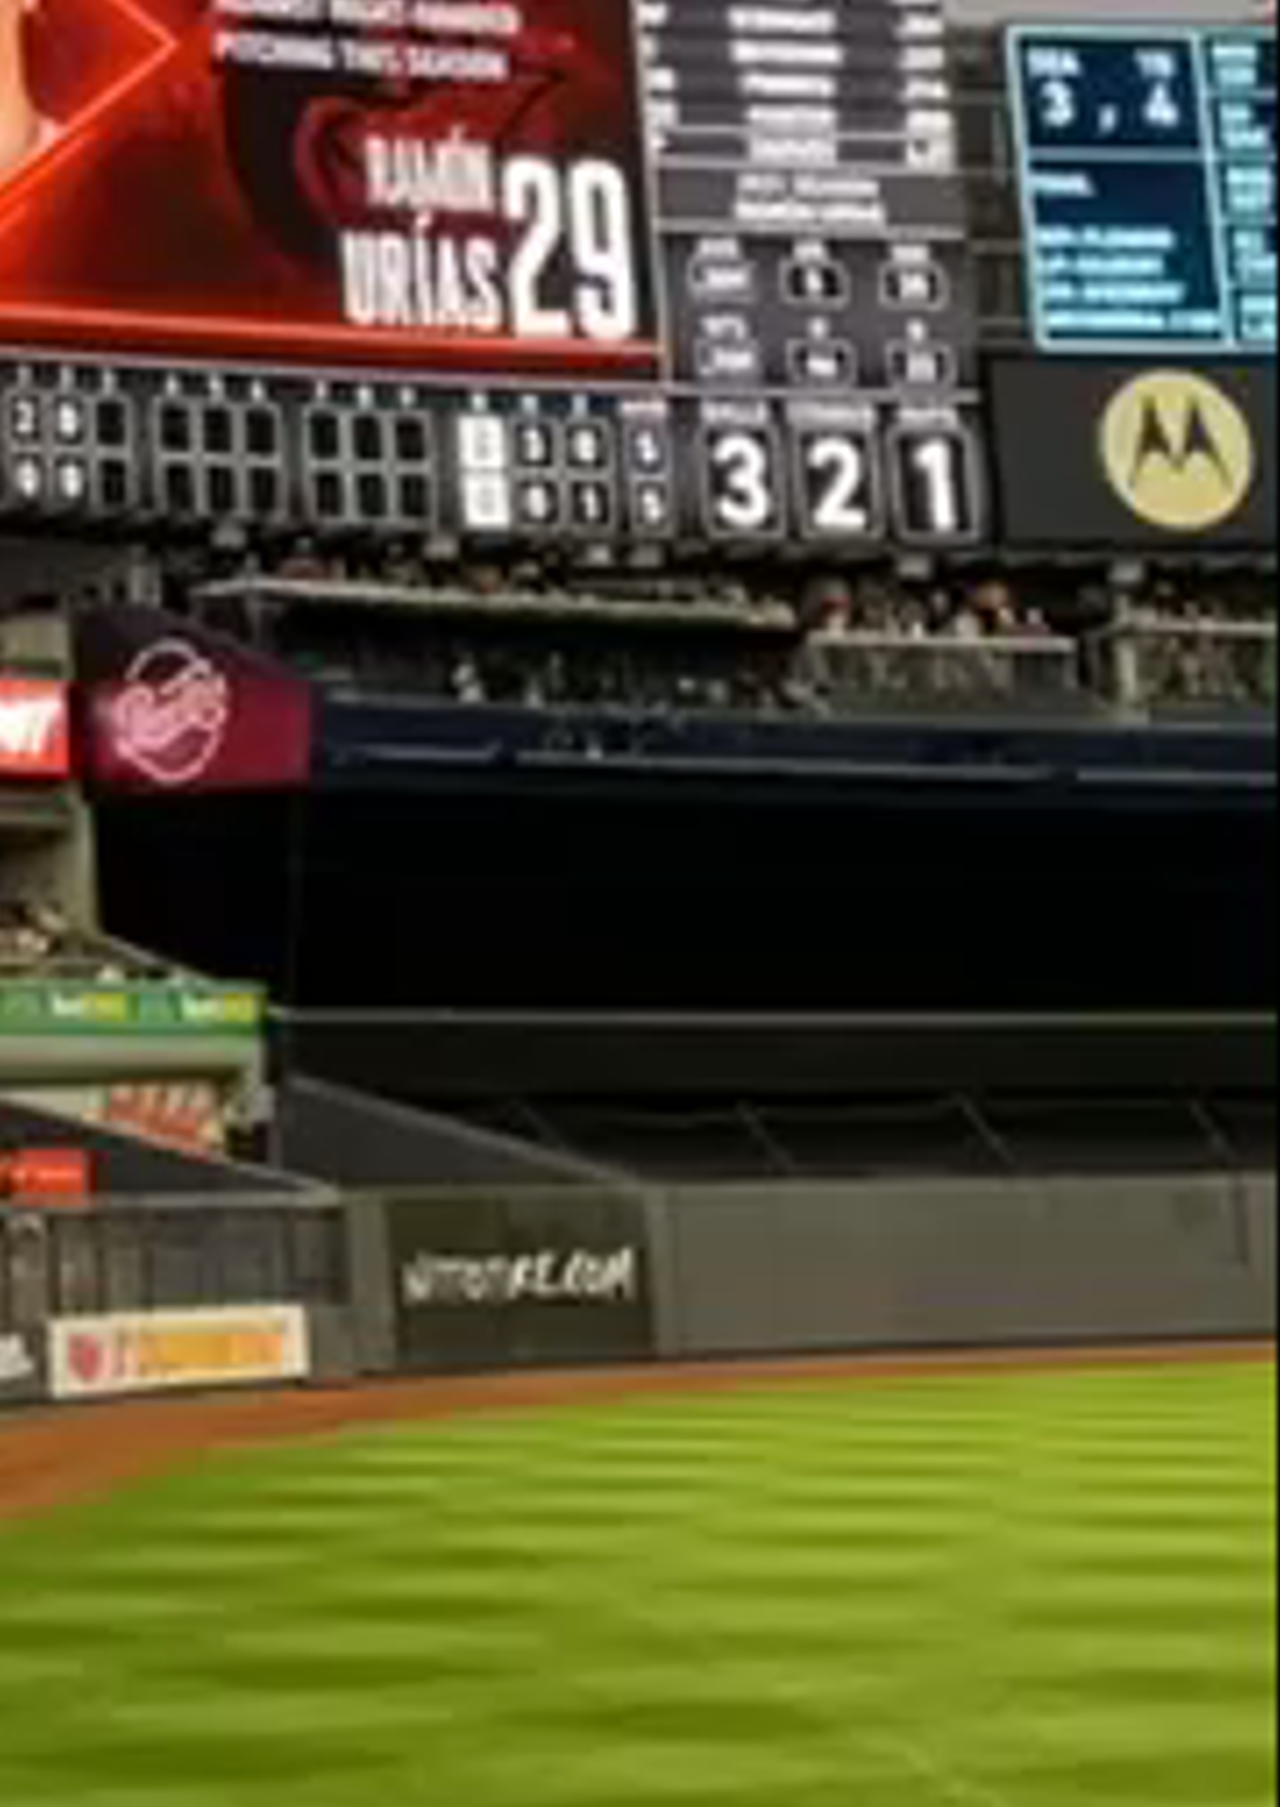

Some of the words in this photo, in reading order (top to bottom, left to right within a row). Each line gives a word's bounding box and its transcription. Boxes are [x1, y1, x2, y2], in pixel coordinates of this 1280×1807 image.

[344, 211, 503, 333] URÍAS
[503, 156, 636, 341] 29
[713, 434, 770, 527] 3
[807, 436, 867, 529] 2
[914, 437, 957, 531] 1
